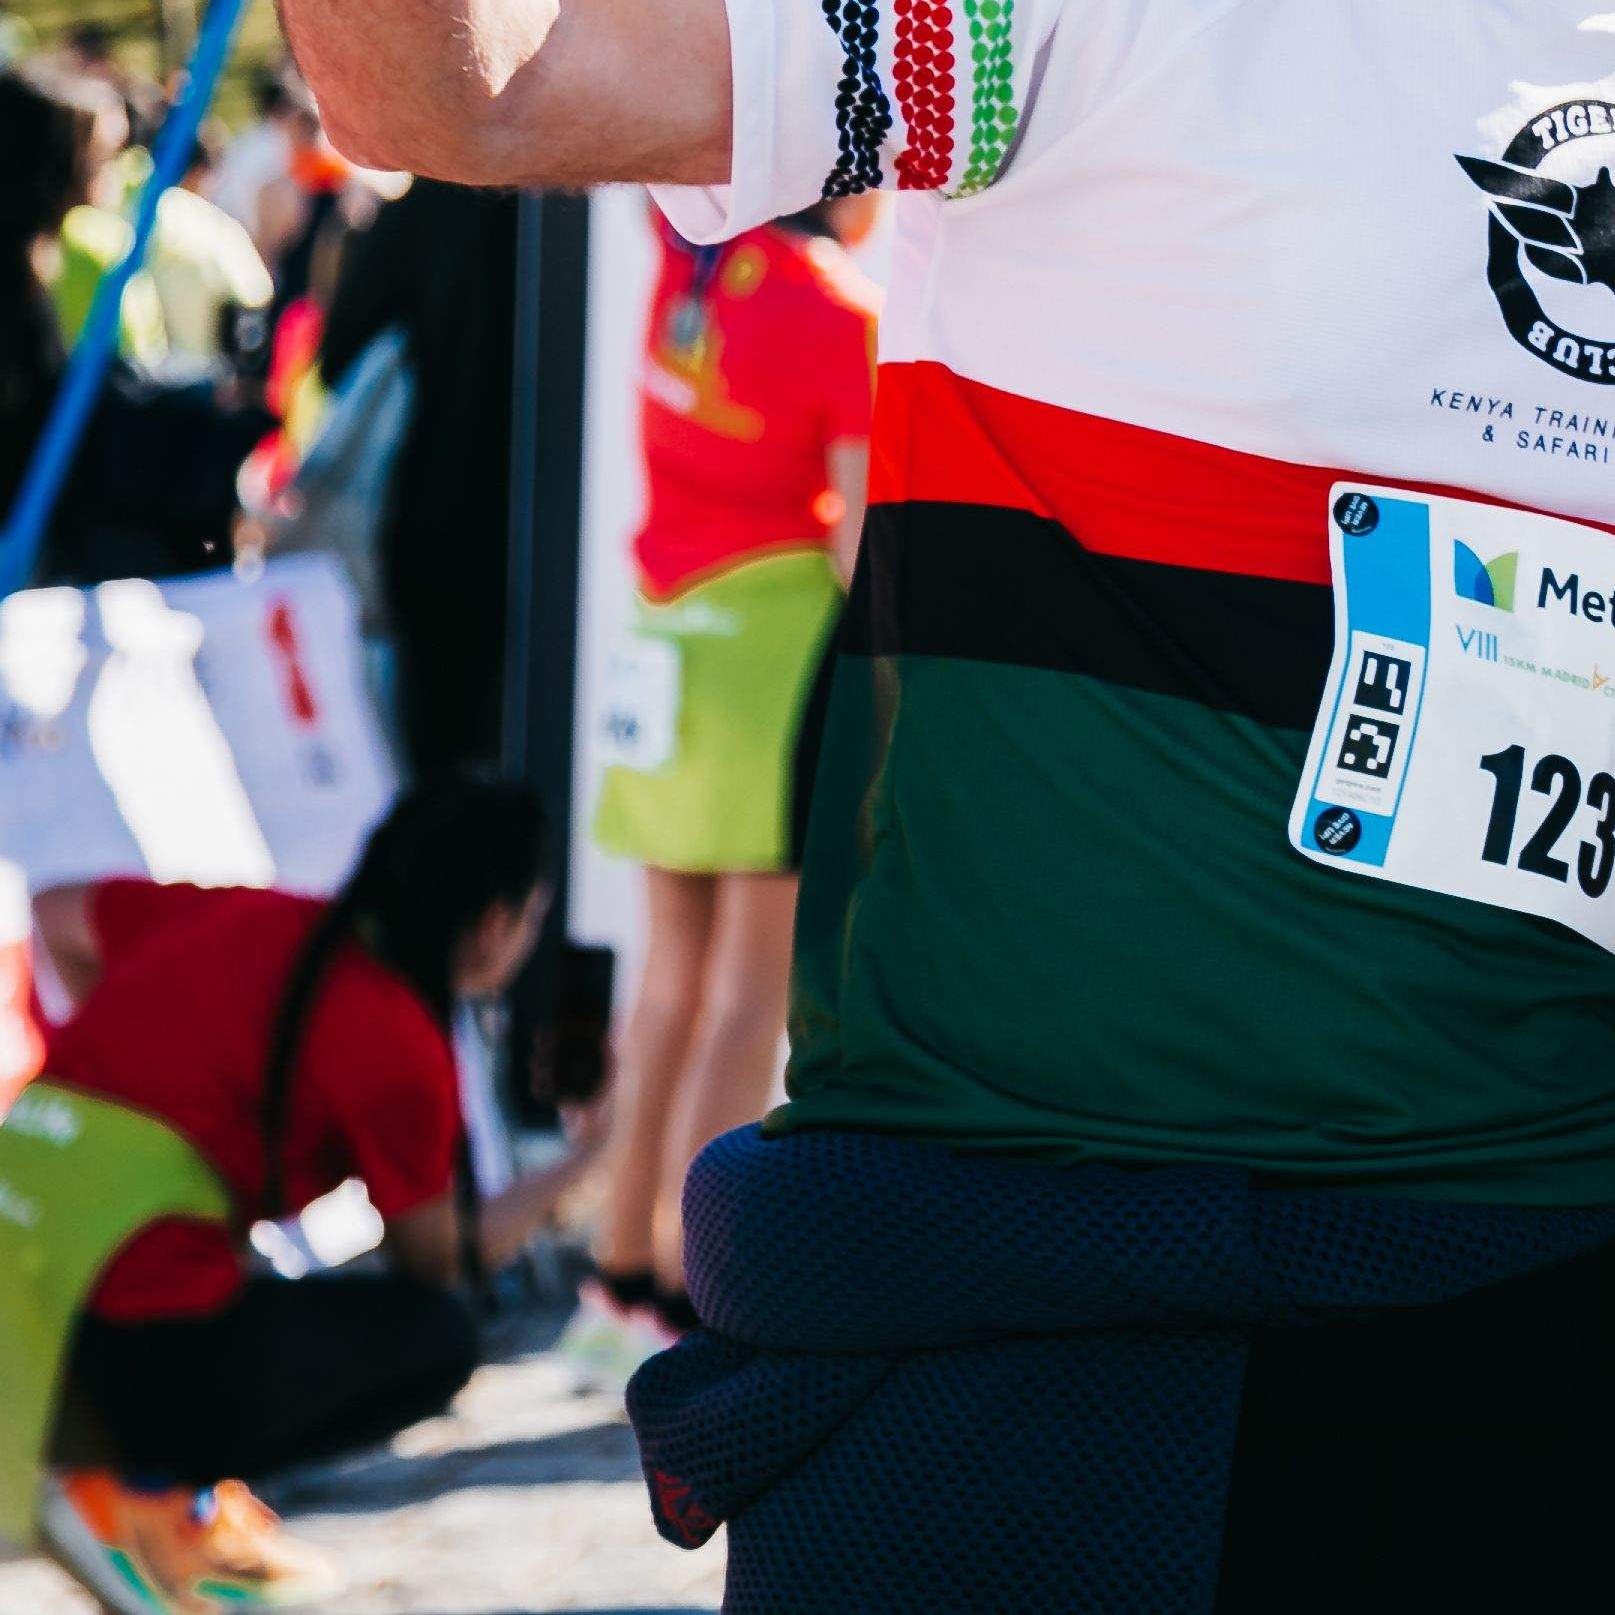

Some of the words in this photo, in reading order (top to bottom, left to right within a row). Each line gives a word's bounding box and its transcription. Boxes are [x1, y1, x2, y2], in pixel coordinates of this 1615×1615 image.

[1431, 388, 1514, 420] KENYA
[1481, 424, 1495, 443] &
[1516, 431, 1610, 464] SAFARI
[1455, 624, 1498, 662] VIII
[1503, 655, 1537, 674] 15KM
[1541, 666, 1590, 690] MADRID
